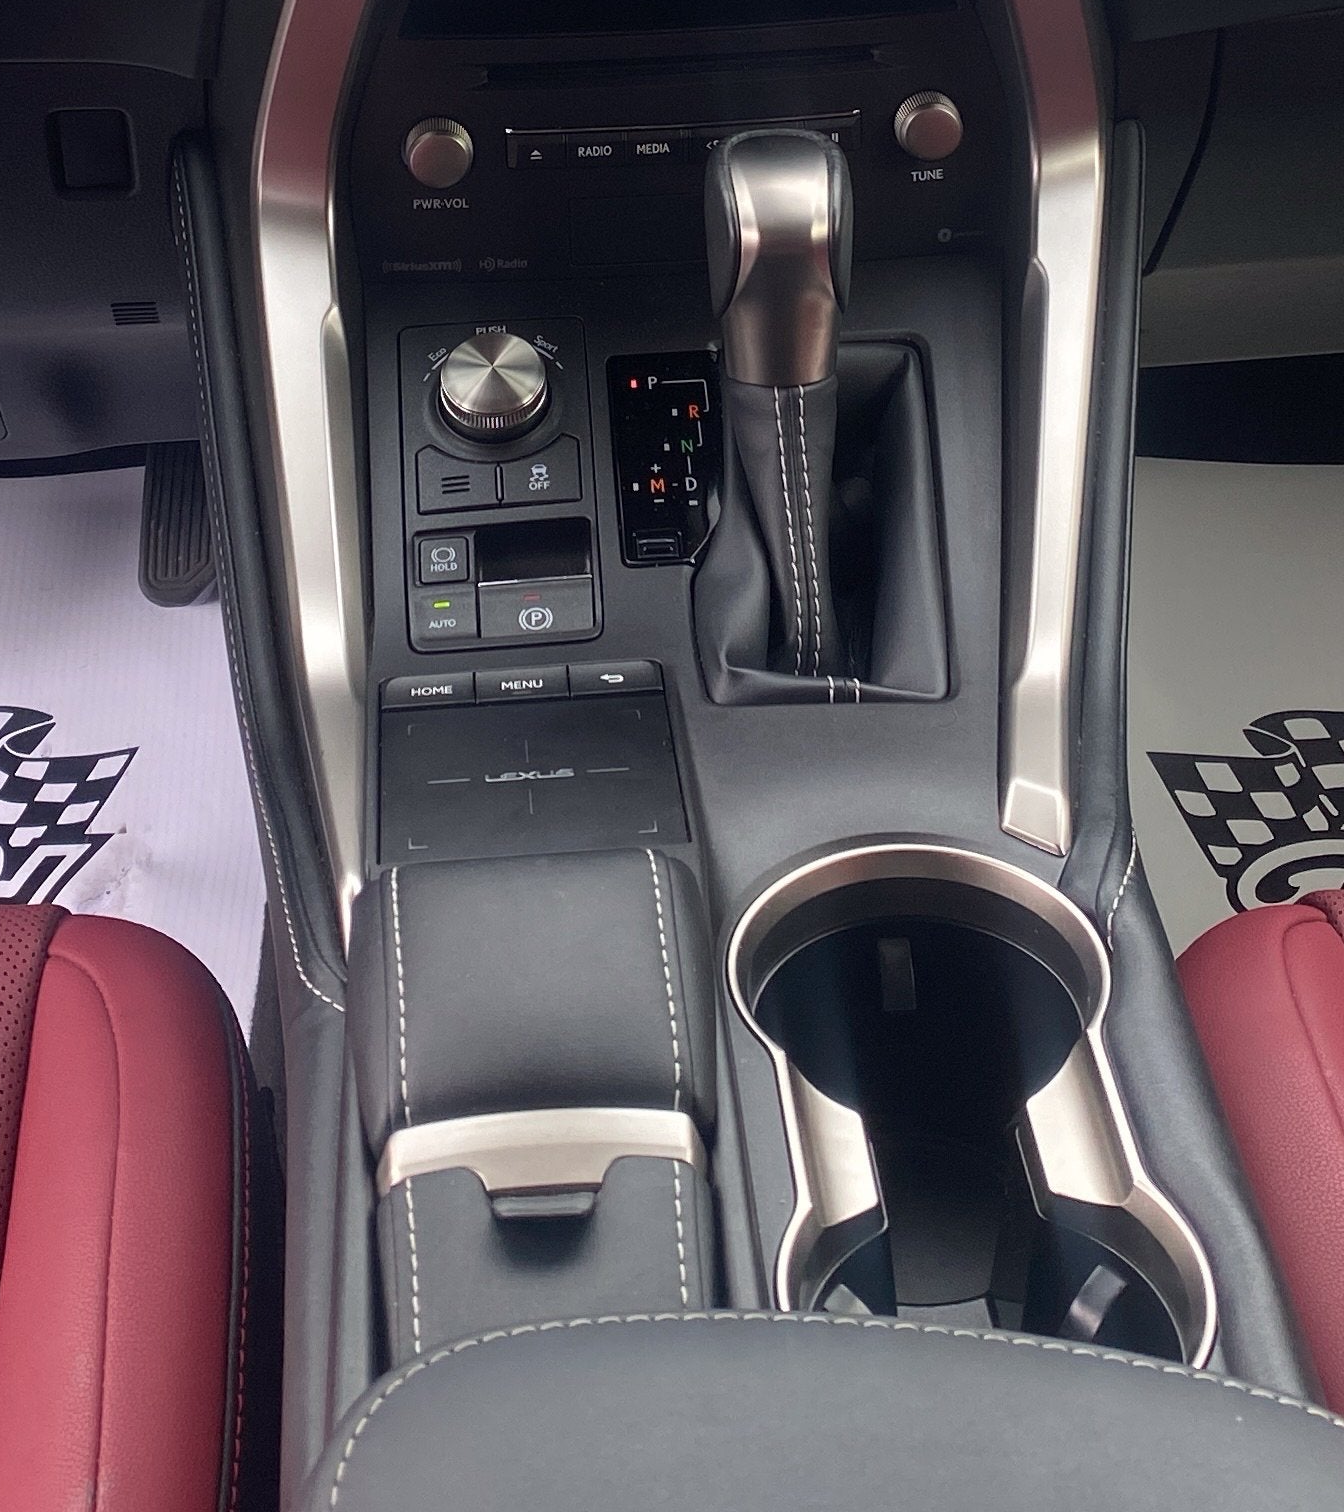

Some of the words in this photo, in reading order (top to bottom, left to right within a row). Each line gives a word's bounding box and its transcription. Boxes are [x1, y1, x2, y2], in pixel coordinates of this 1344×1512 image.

[577, 144, 613, 158] RADIO
[635, 143, 671, 156] MEDIA
[910, 168, 945, 183] TUNE
[533, 334, 559, 354] Sport
[427, 347, 447, 362] Eco
[647, 376, 658, 390] P
[688, 404, 700, 418] R
[680, 439, 694, 453] N
[528, 480, 551, 491] OFF
[650, 477, 666, 493] M
[684, 476, 698, 492] D
[430, 562, 458, 573] HOLD
[428, 618, 457, 629] AUTO
[410, 684, 453, 697] HOME
[500, 678, 544, 691] MENU
[484, 767, 575, 783] LEXUS
